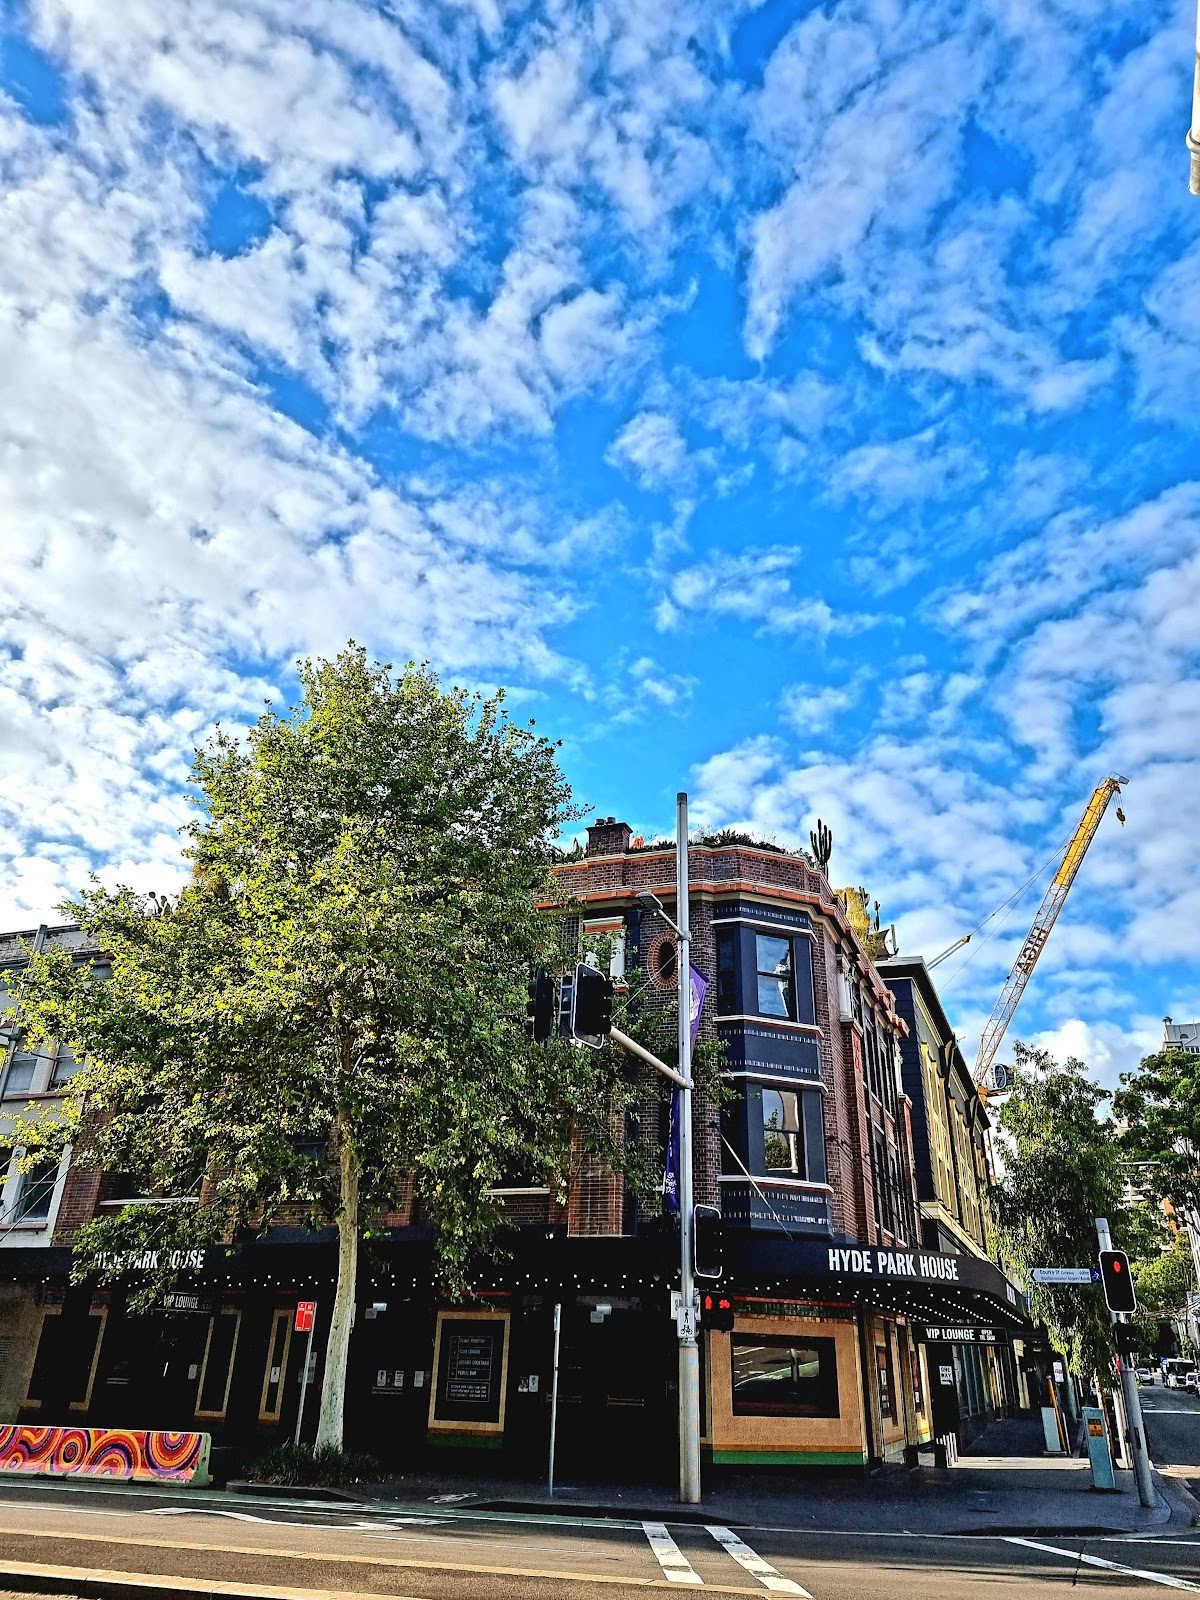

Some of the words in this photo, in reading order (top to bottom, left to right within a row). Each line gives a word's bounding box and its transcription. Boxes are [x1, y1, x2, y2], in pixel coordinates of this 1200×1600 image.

[127, 1250, 160, 1269] PARK
[163, 1250, 205, 1269] OUSE
[828, 1249, 873, 1273] HYDE
[877, 1251, 917, 1276] PARK
[919, 1255, 960, 1281] HOUSE
[175, 1295, 199, 1309] LOUNGE
[926, 1328, 940, 1339] VIP
[942, 1329, 975, 1341] LOUNGE
